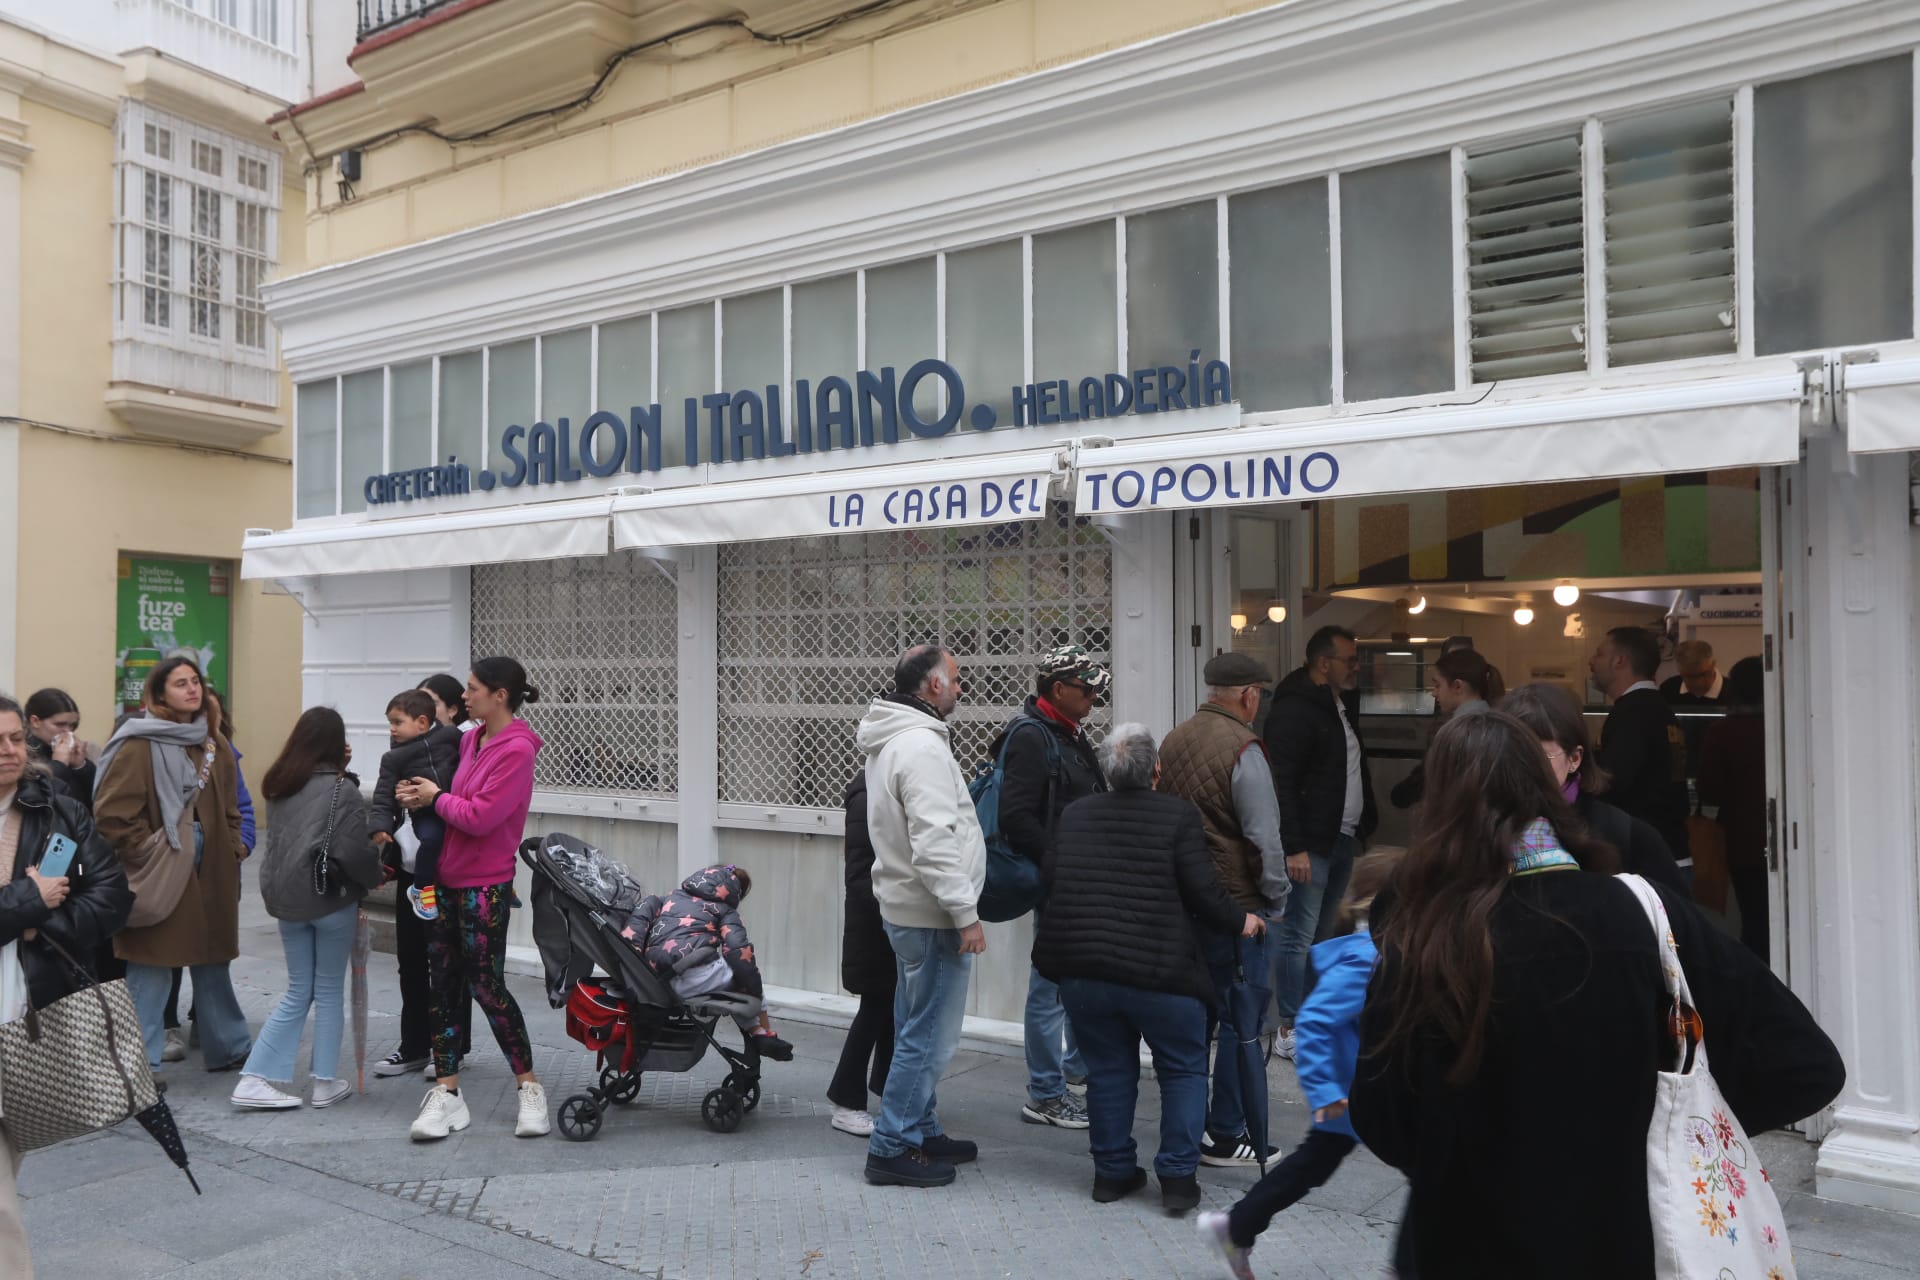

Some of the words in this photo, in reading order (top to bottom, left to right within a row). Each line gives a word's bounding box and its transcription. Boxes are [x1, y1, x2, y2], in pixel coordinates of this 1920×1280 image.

[364, 456, 470, 504] CAFETERÍA
[500, 403, 662, 486] SALON
[685, 359, 964, 465] ITALIANO
[1013, 349, 1232, 427] HELADERÍA
[829, 494, 864, 527] LA
[883, 485, 967, 524] CASA
[981, 479, 1041, 517] DEL
[1086, 452, 1340, 510] TOPOLINO
[174, 575, 184, 584] de
[138, 594, 186, 617] fuze
[138, 615, 174, 631] tea
